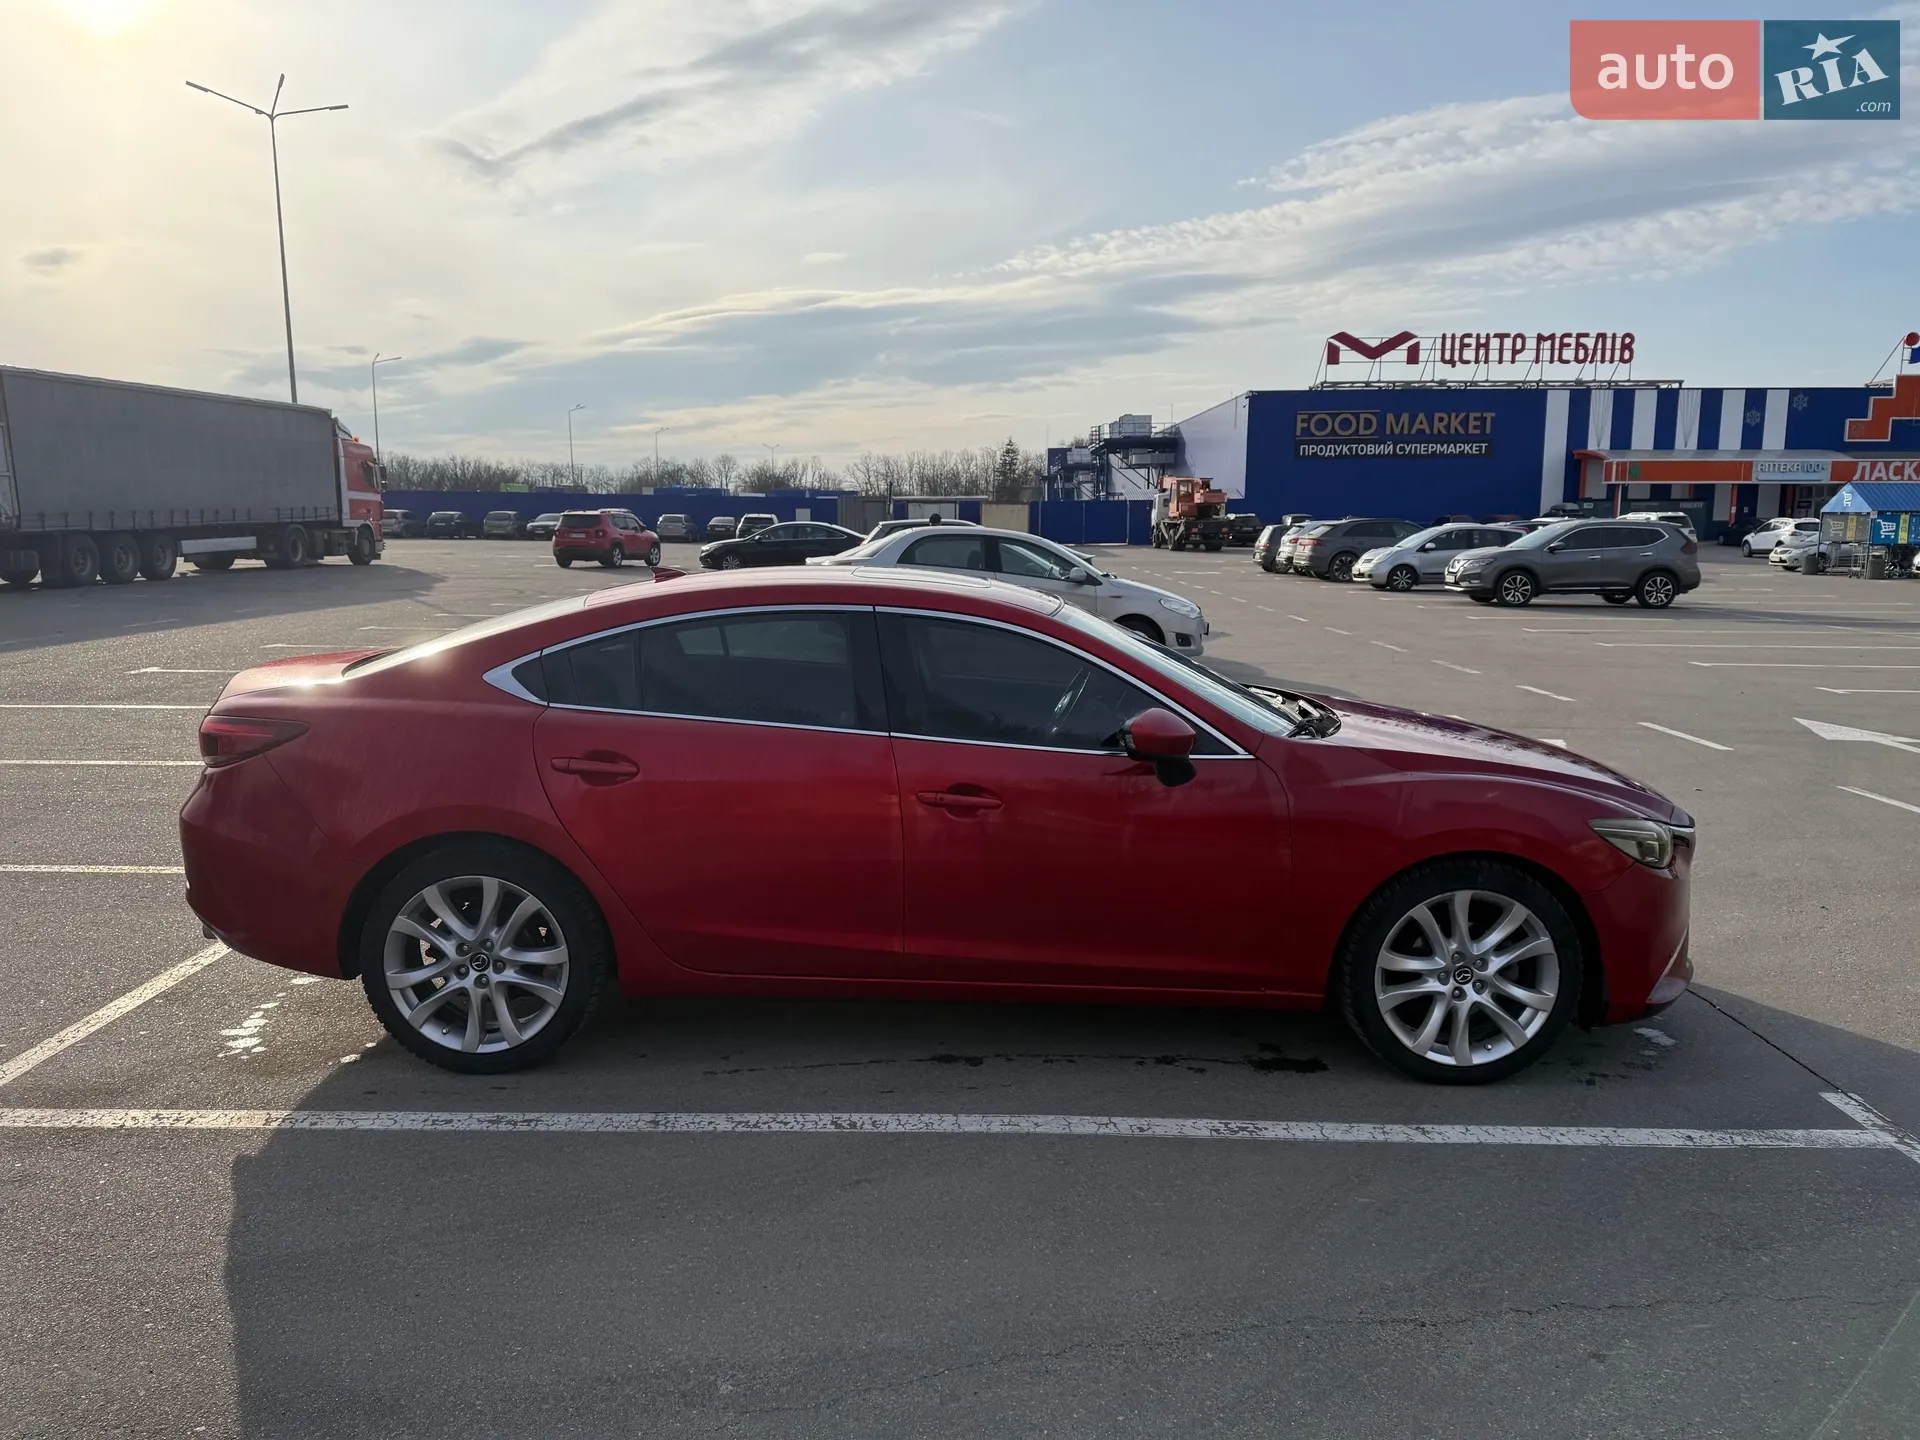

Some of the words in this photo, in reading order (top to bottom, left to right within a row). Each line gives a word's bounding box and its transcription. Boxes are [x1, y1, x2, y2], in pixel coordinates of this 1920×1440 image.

[1440, 332, 1527, 368] ЦЕНТР
[1534, 332, 1636, 365] МЕБЛІВ
[1295, 413, 1378, 437] FOOD
[1384, 412, 1496, 435] MARKET
[1299, 441, 1394, 458] ПРОДУКТОВИЙ
[1396, 442, 1489, 456] СУПЕРМАРКЕТ
[1756, 461, 1801, 473] АПТЕКА
[1852, 461, 1920, 481] ЛАСК
